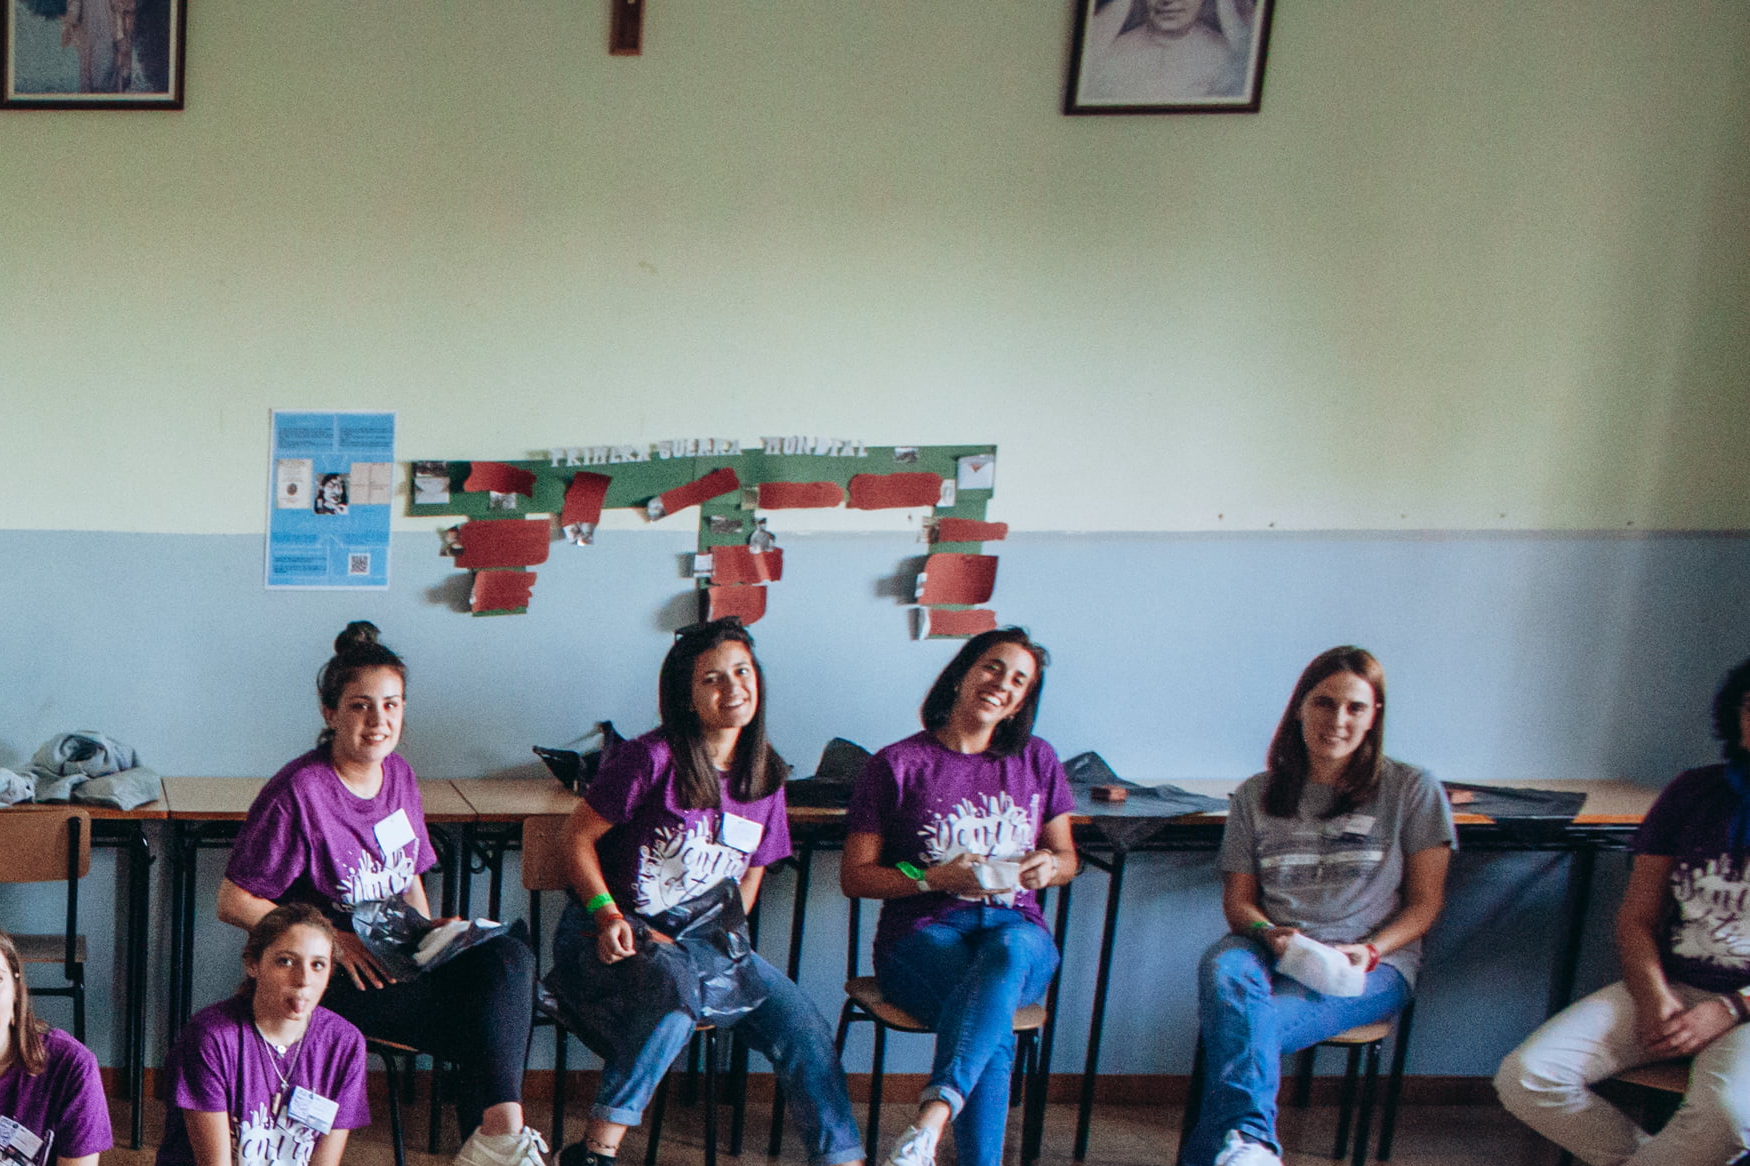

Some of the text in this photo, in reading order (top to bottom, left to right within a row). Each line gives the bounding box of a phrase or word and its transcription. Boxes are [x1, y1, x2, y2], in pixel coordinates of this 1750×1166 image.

[549, 435, 869, 468] PRIMERA GUERRA MUNDIAL
